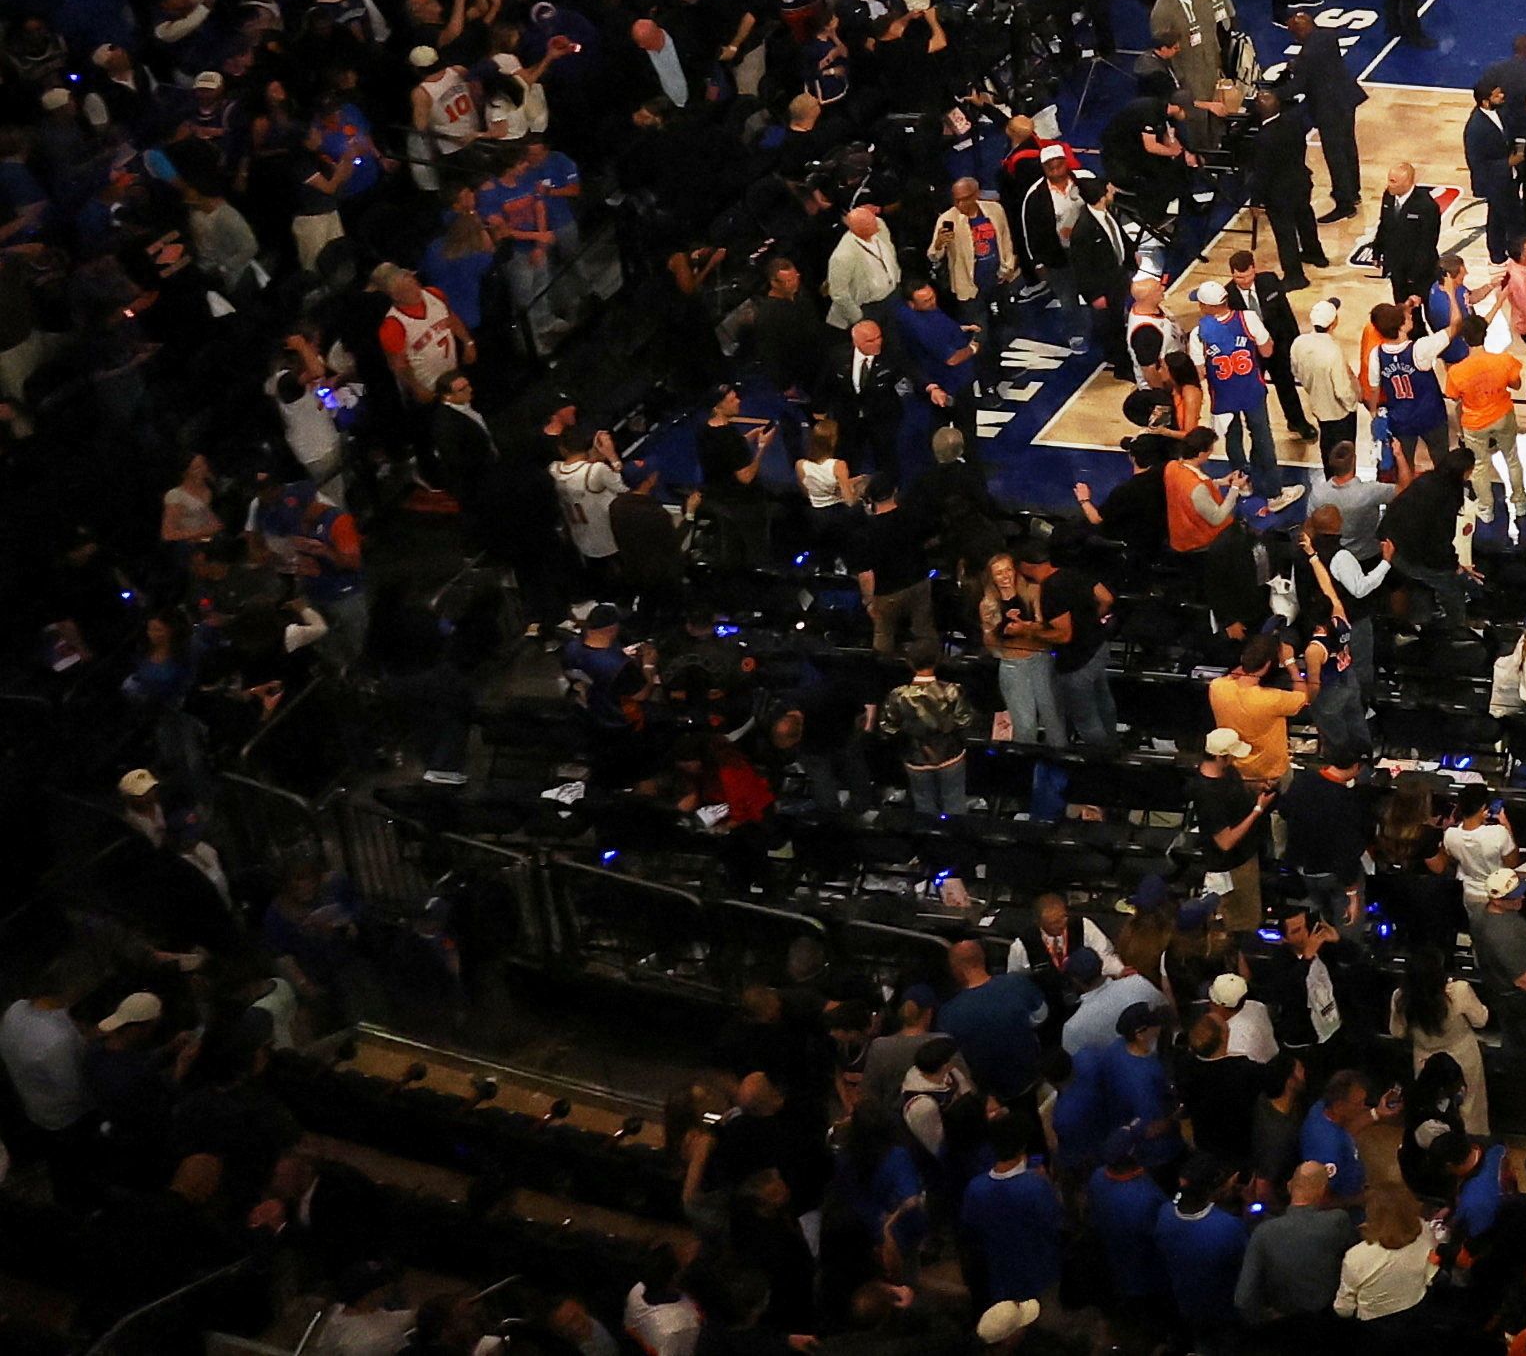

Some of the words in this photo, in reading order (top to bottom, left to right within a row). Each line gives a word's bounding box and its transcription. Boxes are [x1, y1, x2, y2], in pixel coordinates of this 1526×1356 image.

[444, 94, 474, 125] 10
[436, 336, 454, 360] 7
[1212, 349, 1254, 382] 36
[1391, 374, 1416, 400] 11
